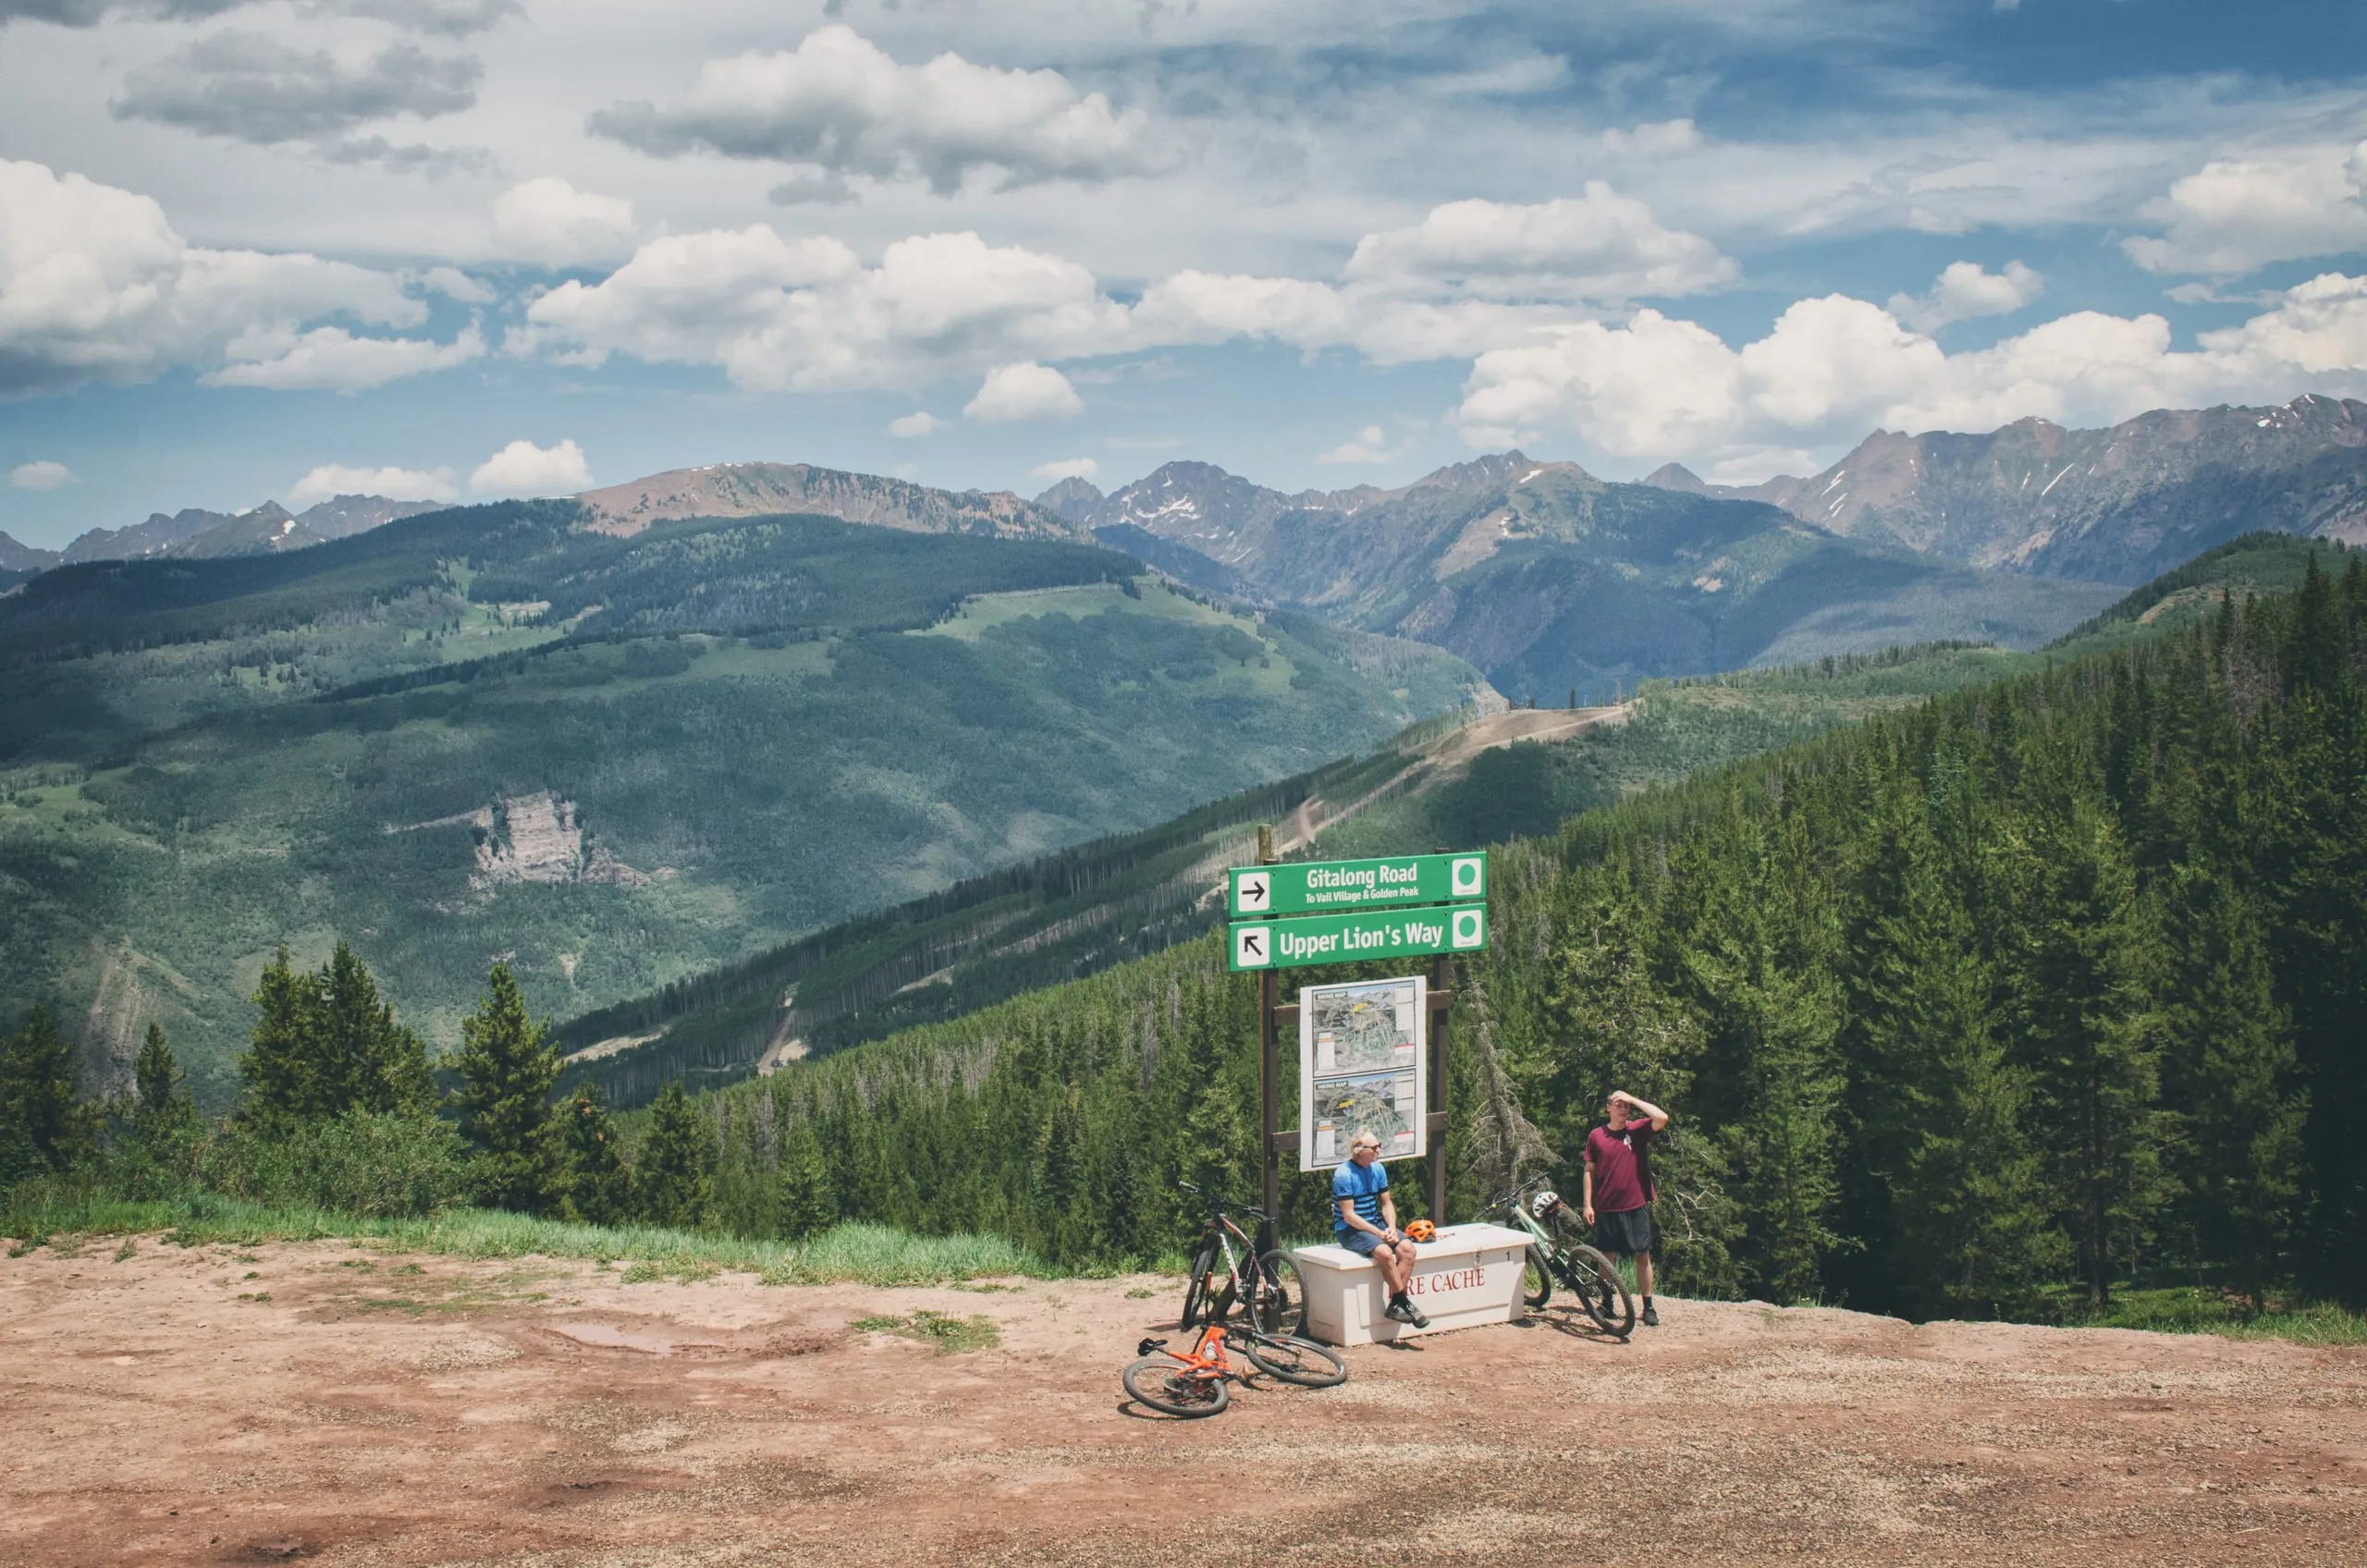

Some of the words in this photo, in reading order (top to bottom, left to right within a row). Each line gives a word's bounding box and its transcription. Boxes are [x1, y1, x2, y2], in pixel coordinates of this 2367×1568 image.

[1306, 866, 1376, 888] Gitalong
[1380, 863, 1417, 883] Road
[1306, 893, 1315, 903] To
[1316, 892, 1332, 902] Vail
[1333, 890, 1361, 903] Village
[1362, 889, 1369, 900] &
[1370, 888, 1398, 899] Golden
[1399, 886, 1419, 897] Peak
[1280, 932, 1339, 960] Upper
[1343, 925, 1401, 949] Lion's
[1404, 922, 1443, 948] Way
[1504, 1250, 1510, 1261] 1
[1388, 1276, 1426, 1299] RE
[1431, 1268, 1485, 1292] CACHE
